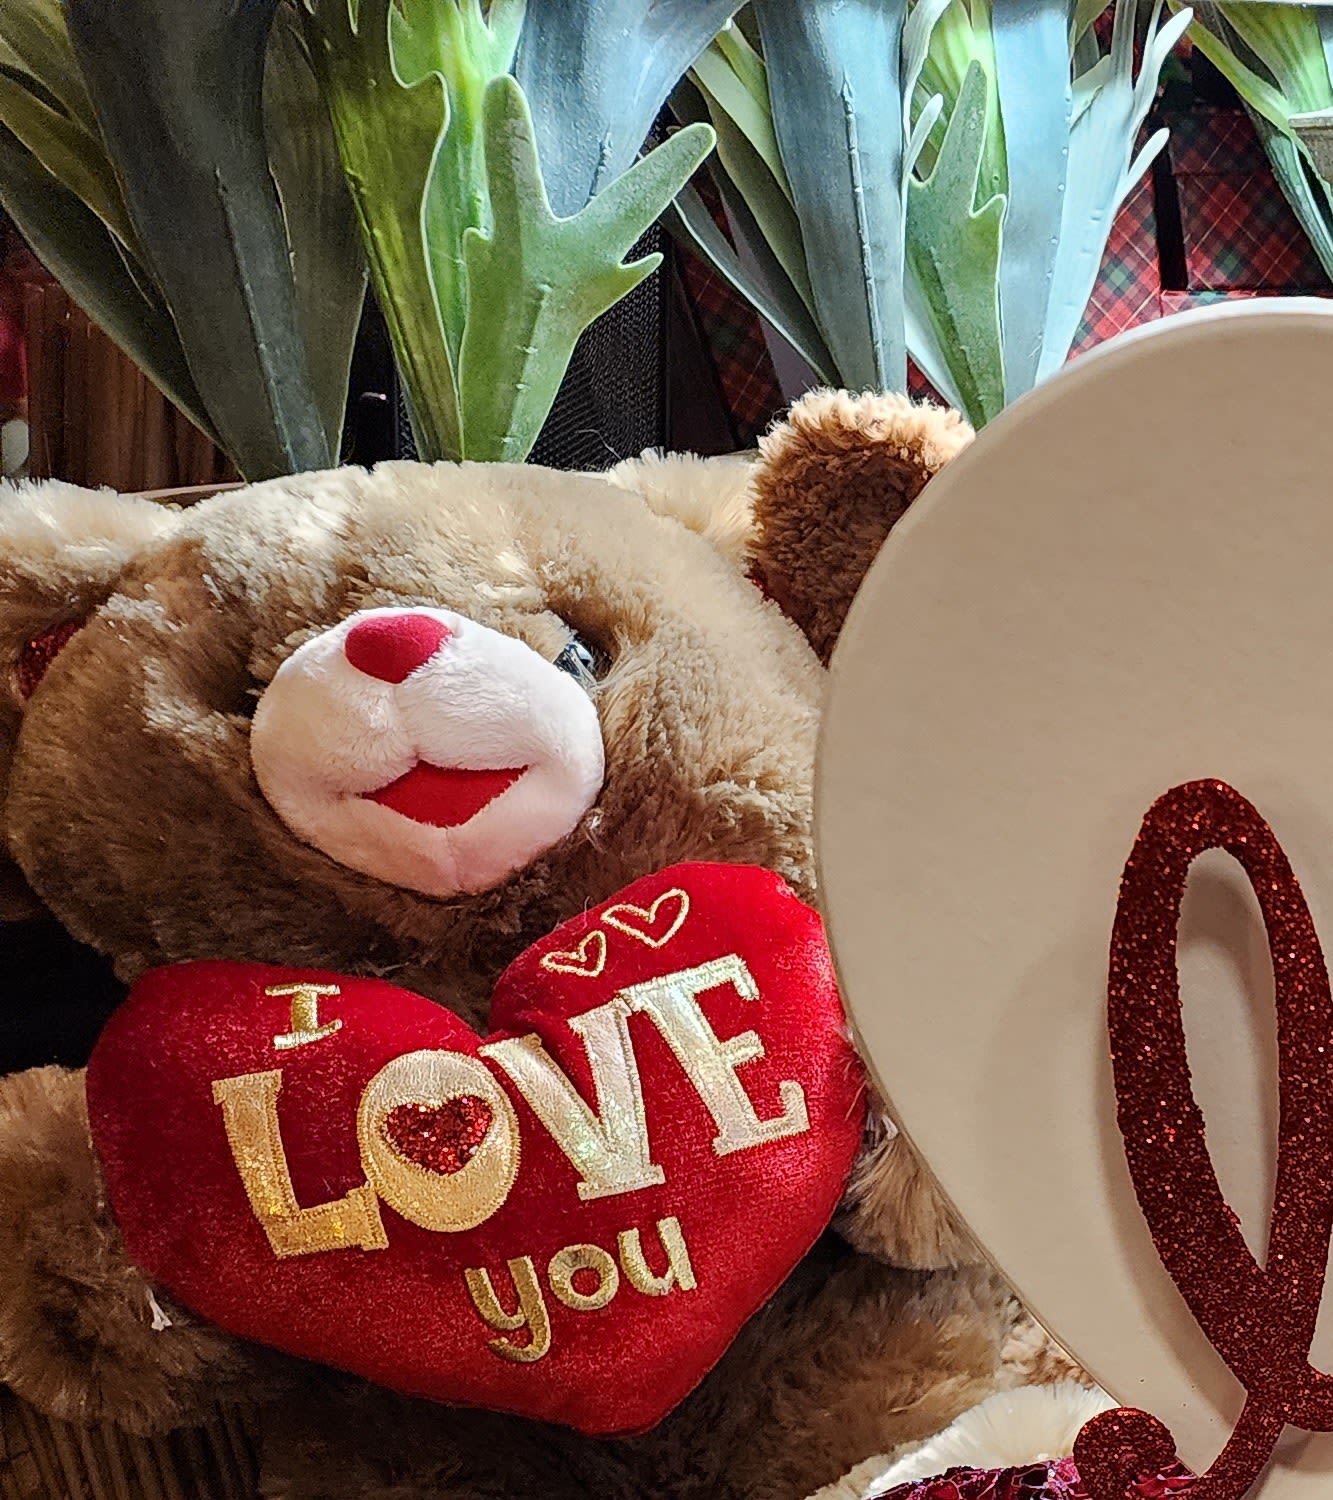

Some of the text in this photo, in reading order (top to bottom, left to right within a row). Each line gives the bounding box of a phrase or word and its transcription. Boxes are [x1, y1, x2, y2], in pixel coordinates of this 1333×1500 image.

[264, 983, 343, 1050] I
[211, 953, 811, 1259] LOVE
[465, 1216, 699, 1364] you
